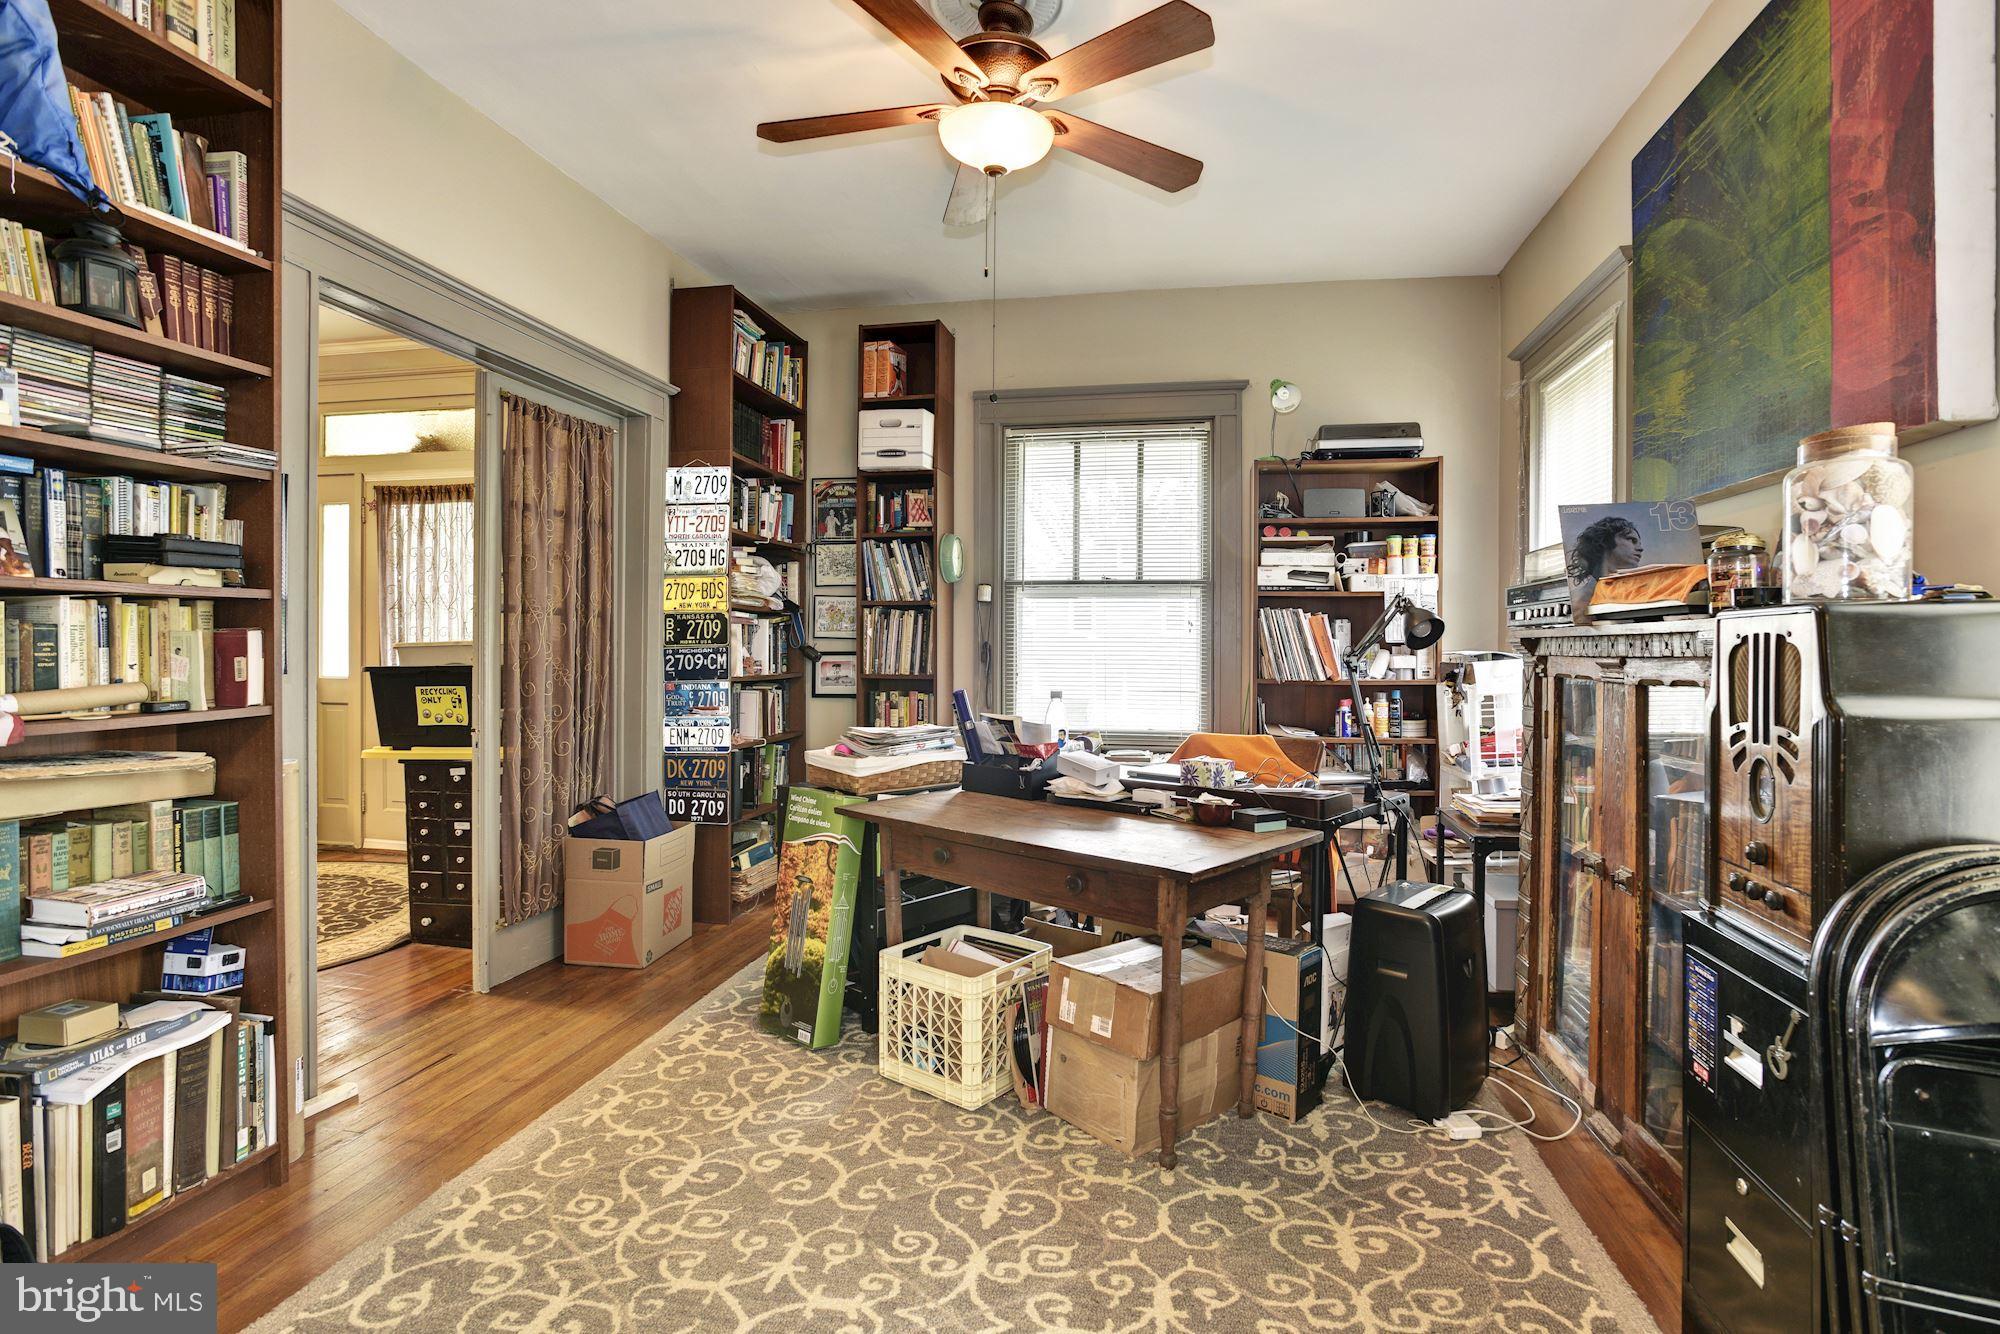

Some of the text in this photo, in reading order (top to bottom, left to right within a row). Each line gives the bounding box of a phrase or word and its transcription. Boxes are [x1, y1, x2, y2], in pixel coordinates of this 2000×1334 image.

[674, 474, 728, 495] M 2709
[152, 502, 160, 522] Birds
[1650, 501, 1698, 532] 13
[668, 515, 726, 533] YTT-2709
[674, 548, 725, 567] 2709 HG
[666, 581, 724, 600] 2709-BDS
[686, 620, 722, 640] 2709
[420, 688, 458, 696] RECYCLING
[421, 696, 442, 704] ONLY
[698, 690, 726, 708] 2709
[691, 800, 724, 816] 2709
[790, 794, 817, 804] Wind Chime
[816, 819, 831, 828] viento
[95, 920, 134, 936] ACCIDENTALLY
[110, 923, 154, 940] AMSTERDAM
[89, 1044, 115, 1065] ATLAS
[126, 1032, 147, 1048] BEER
[22, 1142, 33, 1170] BEER
